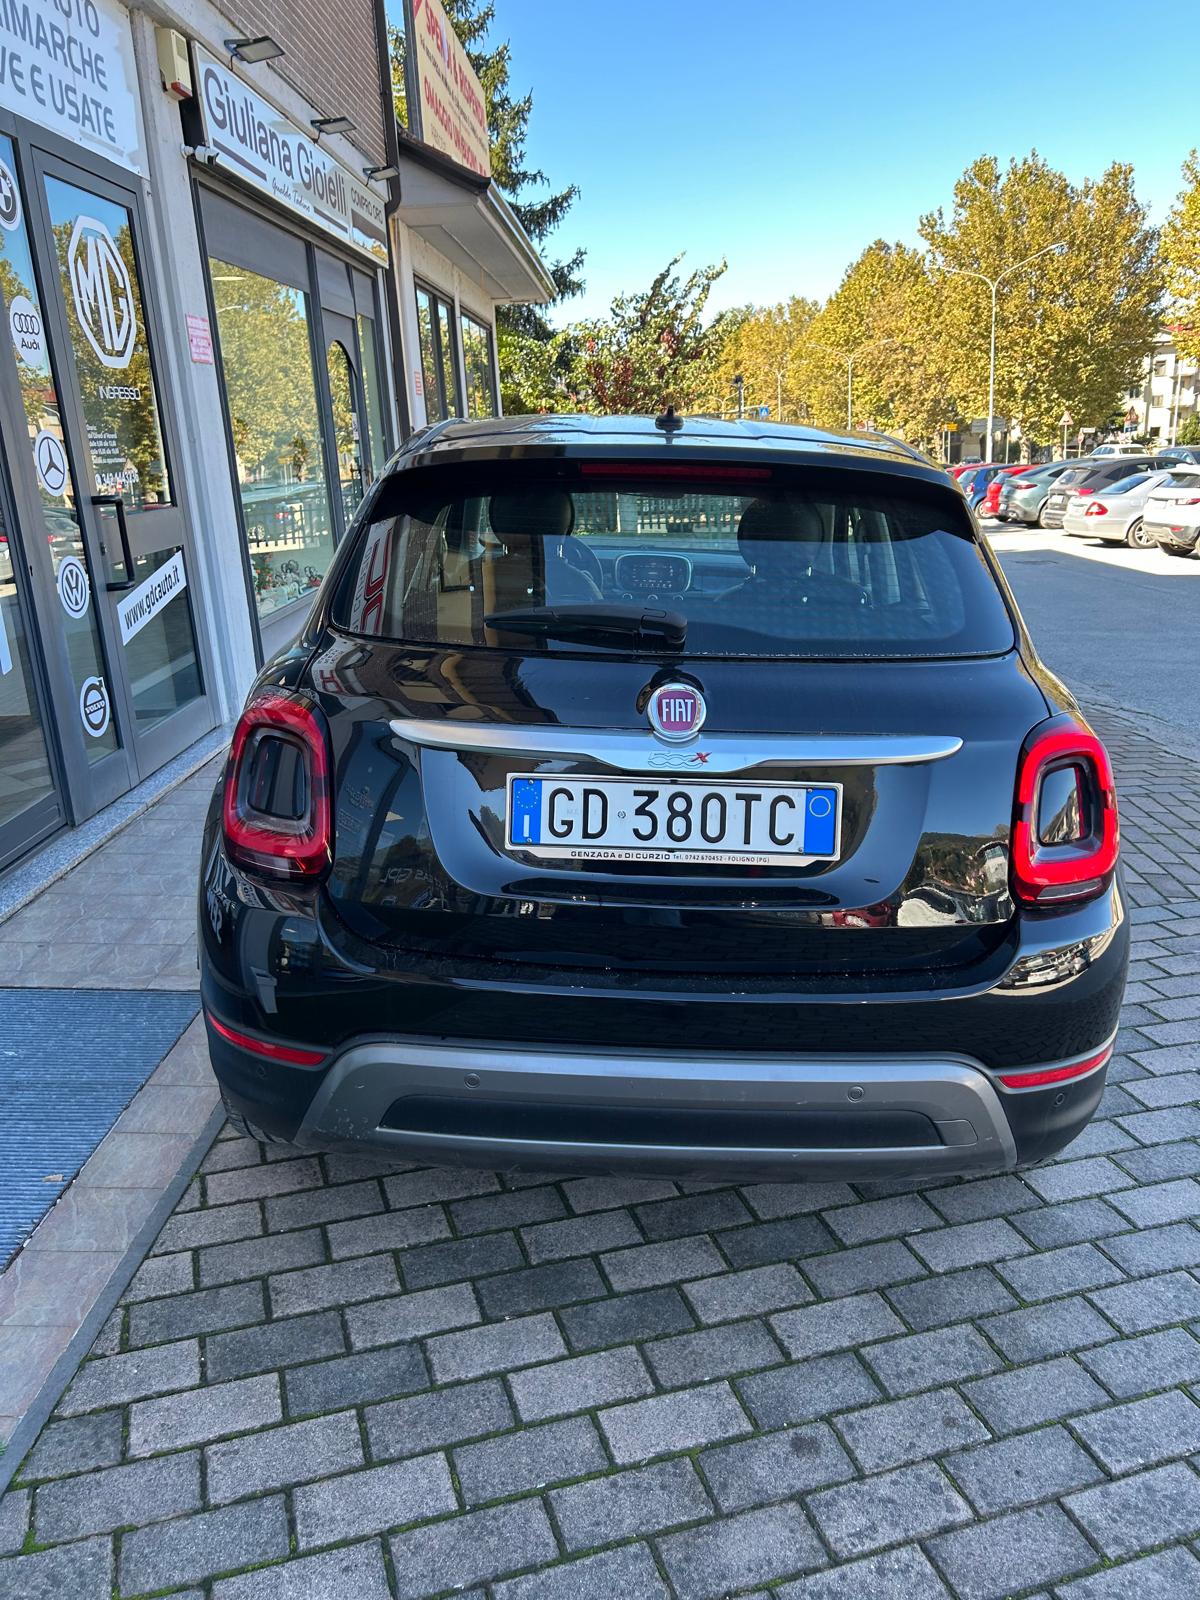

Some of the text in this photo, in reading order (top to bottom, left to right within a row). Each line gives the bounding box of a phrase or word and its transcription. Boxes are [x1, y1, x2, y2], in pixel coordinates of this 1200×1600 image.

[0, 0, 108, 92] IMARCHE
[30, 64, 46, 107] E
[48, 73, 116, 144] USATE
[204, 67, 294, 180] Giuliana
[297, 142, 347, 216] Gioielli
[77, 236, 130, 351] MG
[21, 338, 41, 351] Audi
[99, 385, 141, 400] INGRESSO
[124, 564, 181, 630] www.gdcauto.it
[85, 700, 105, 714] VOLVO
[661, 698, 694, 723] FIAT
[548, 787, 608, 839] GD
[632, 789, 796, 846] 380TC
[570, 850, 616, 859] GENZAGA
[636, 852, 670, 860] CURZIO
